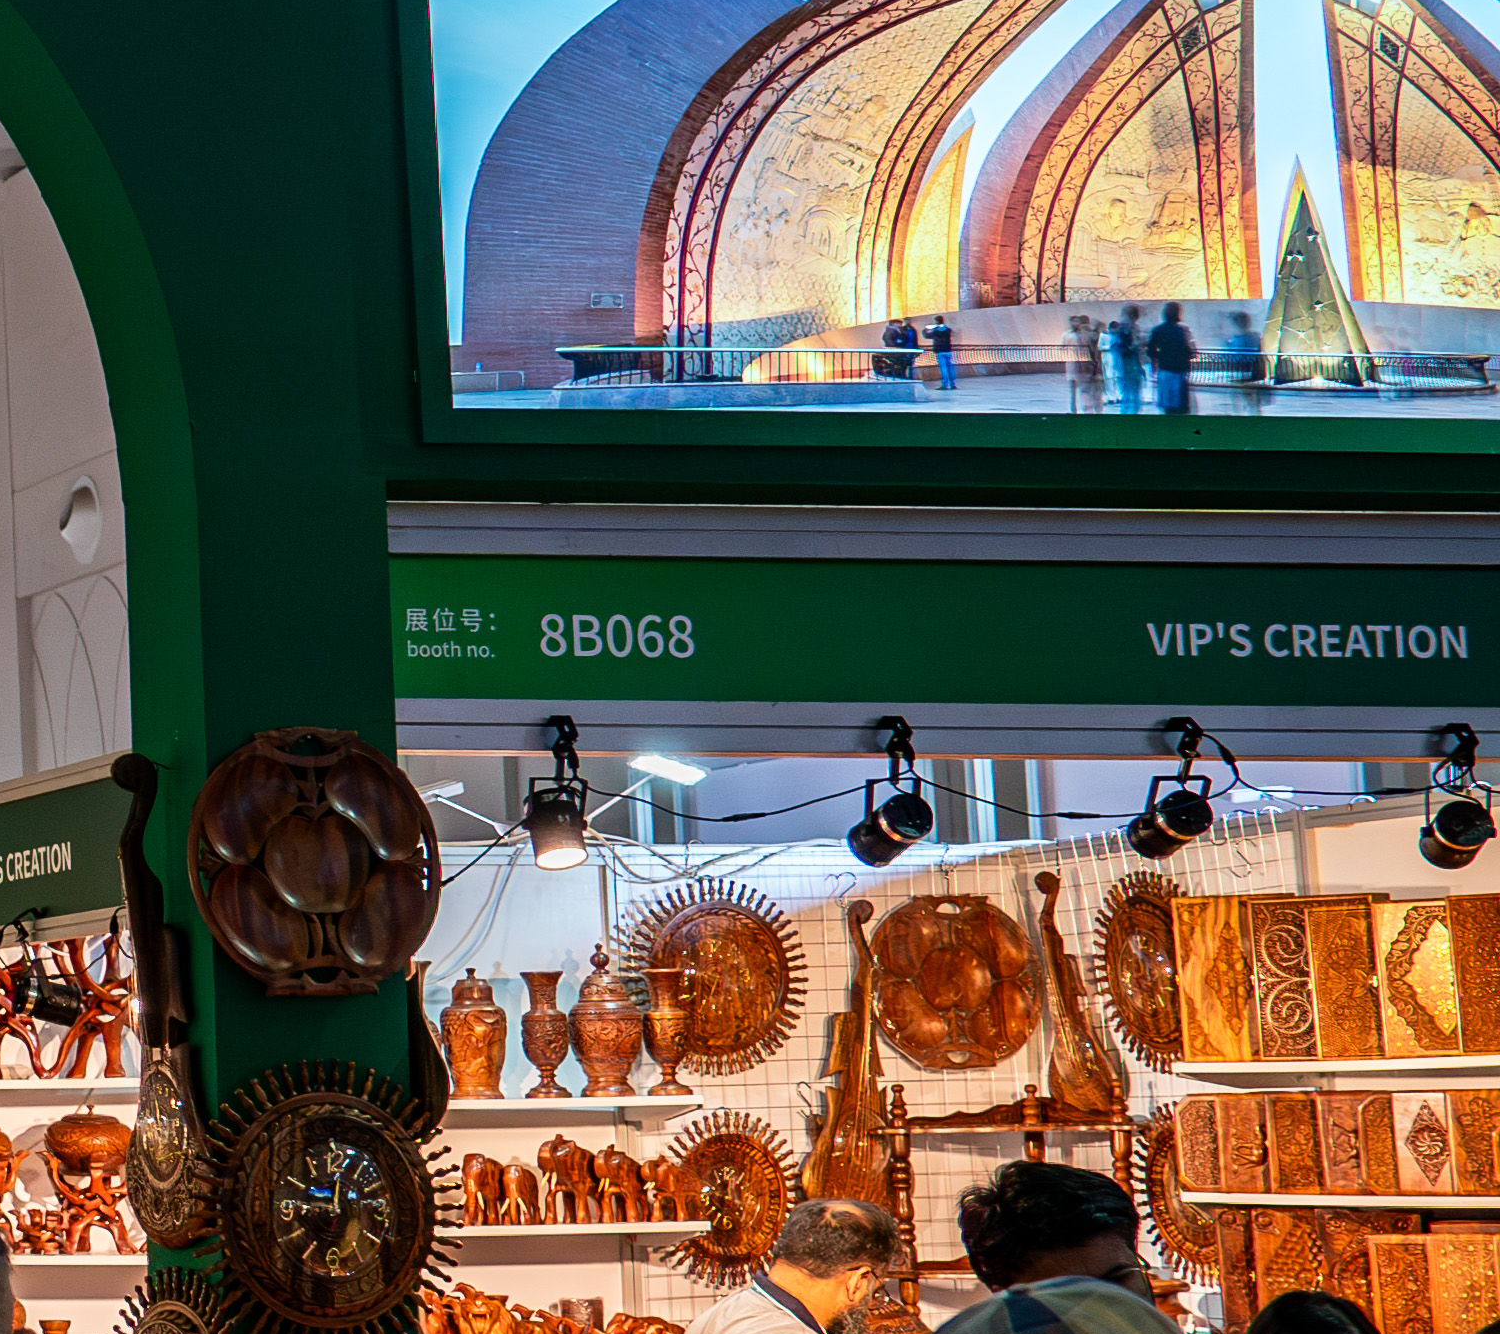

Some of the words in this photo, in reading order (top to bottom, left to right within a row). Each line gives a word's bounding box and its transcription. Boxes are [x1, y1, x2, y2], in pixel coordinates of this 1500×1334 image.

[406, 640, 462, 658] booth
[466, 643, 496, 659] no.
[539, 613, 695, 659] 8B068
[1146, 622, 1254, 658] VIP'S
[1263, 623, 1469, 659] CREATION
[6, 841, 72, 881] CREATION
[326, 1247, 340, 1268] 6
